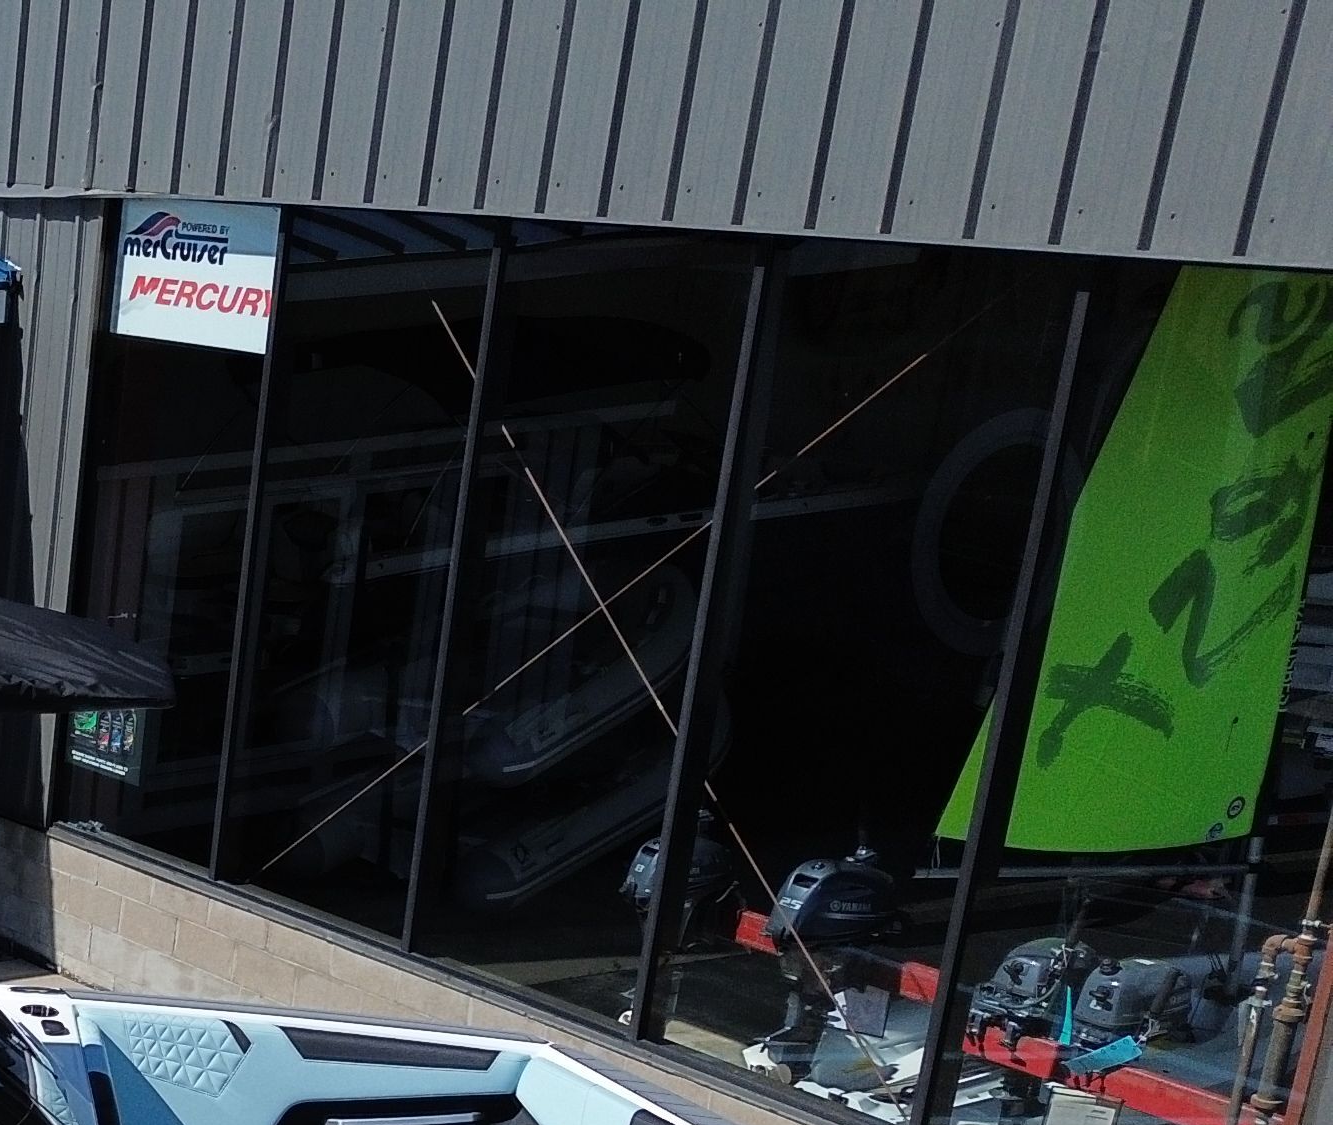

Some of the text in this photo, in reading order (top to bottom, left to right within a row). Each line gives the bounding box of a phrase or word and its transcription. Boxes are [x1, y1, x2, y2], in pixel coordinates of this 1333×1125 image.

[181, 222, 231, 236] POWERED BY
[779, 896, 804, 910] 25
